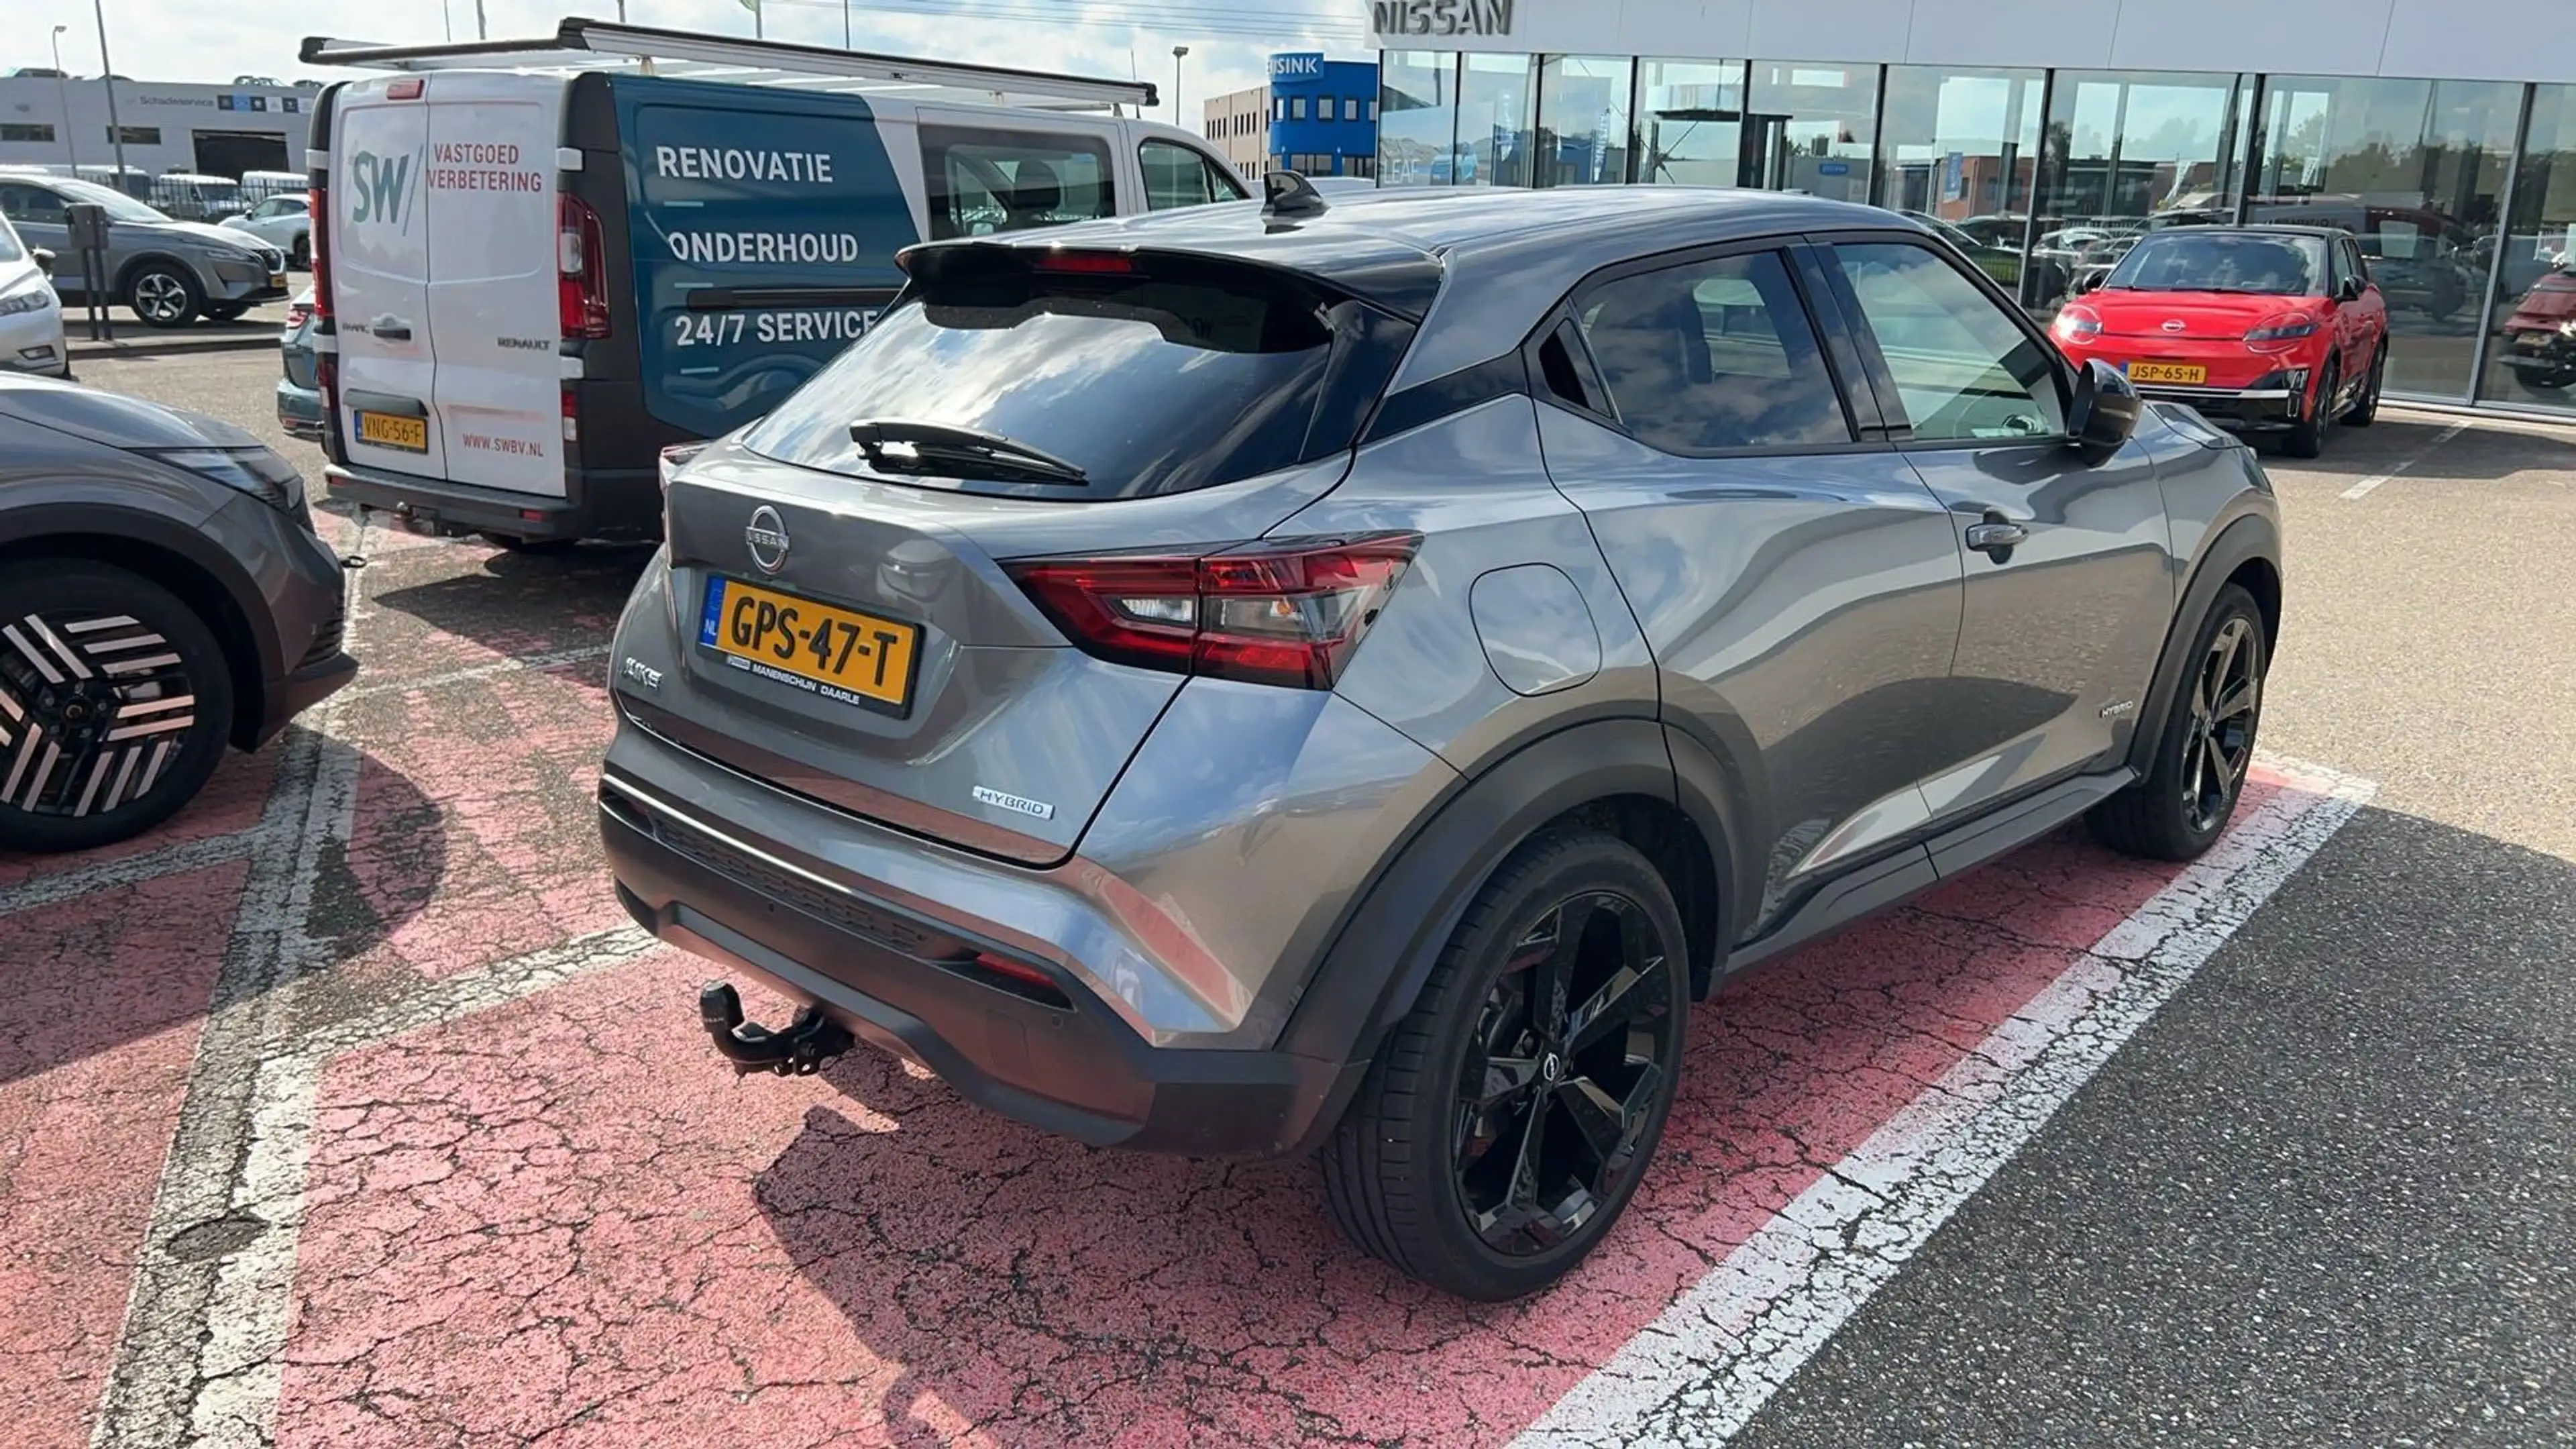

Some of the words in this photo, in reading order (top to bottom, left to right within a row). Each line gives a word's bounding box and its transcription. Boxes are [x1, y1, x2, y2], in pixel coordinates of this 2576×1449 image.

[1373, 0, 1512, 36] NISSAN
[433, 142, 520, 165] VASTGOED
[656, 146, 834, 183] RENOVATIE
[427, 169, 542, 193] VERBETERING
[1384, 158, 1420, 184] LEAF
[668, 231, 859, 263] ONDERHOUD
[674, 313, 746, 347] 24/7
[2131, 365, 2200, 382] JSP-65-H
[364, 415, 422, 444] VNG-56-F
[462, 432, 544, 458] WWW.SWBV.NL
[704, 617, 717, 637] NL
[731, 596, 898, 687] GPS-47-T
[820, 684, 860, 706] DAARLE
[979, 790, 1044, 815] HYBRID
